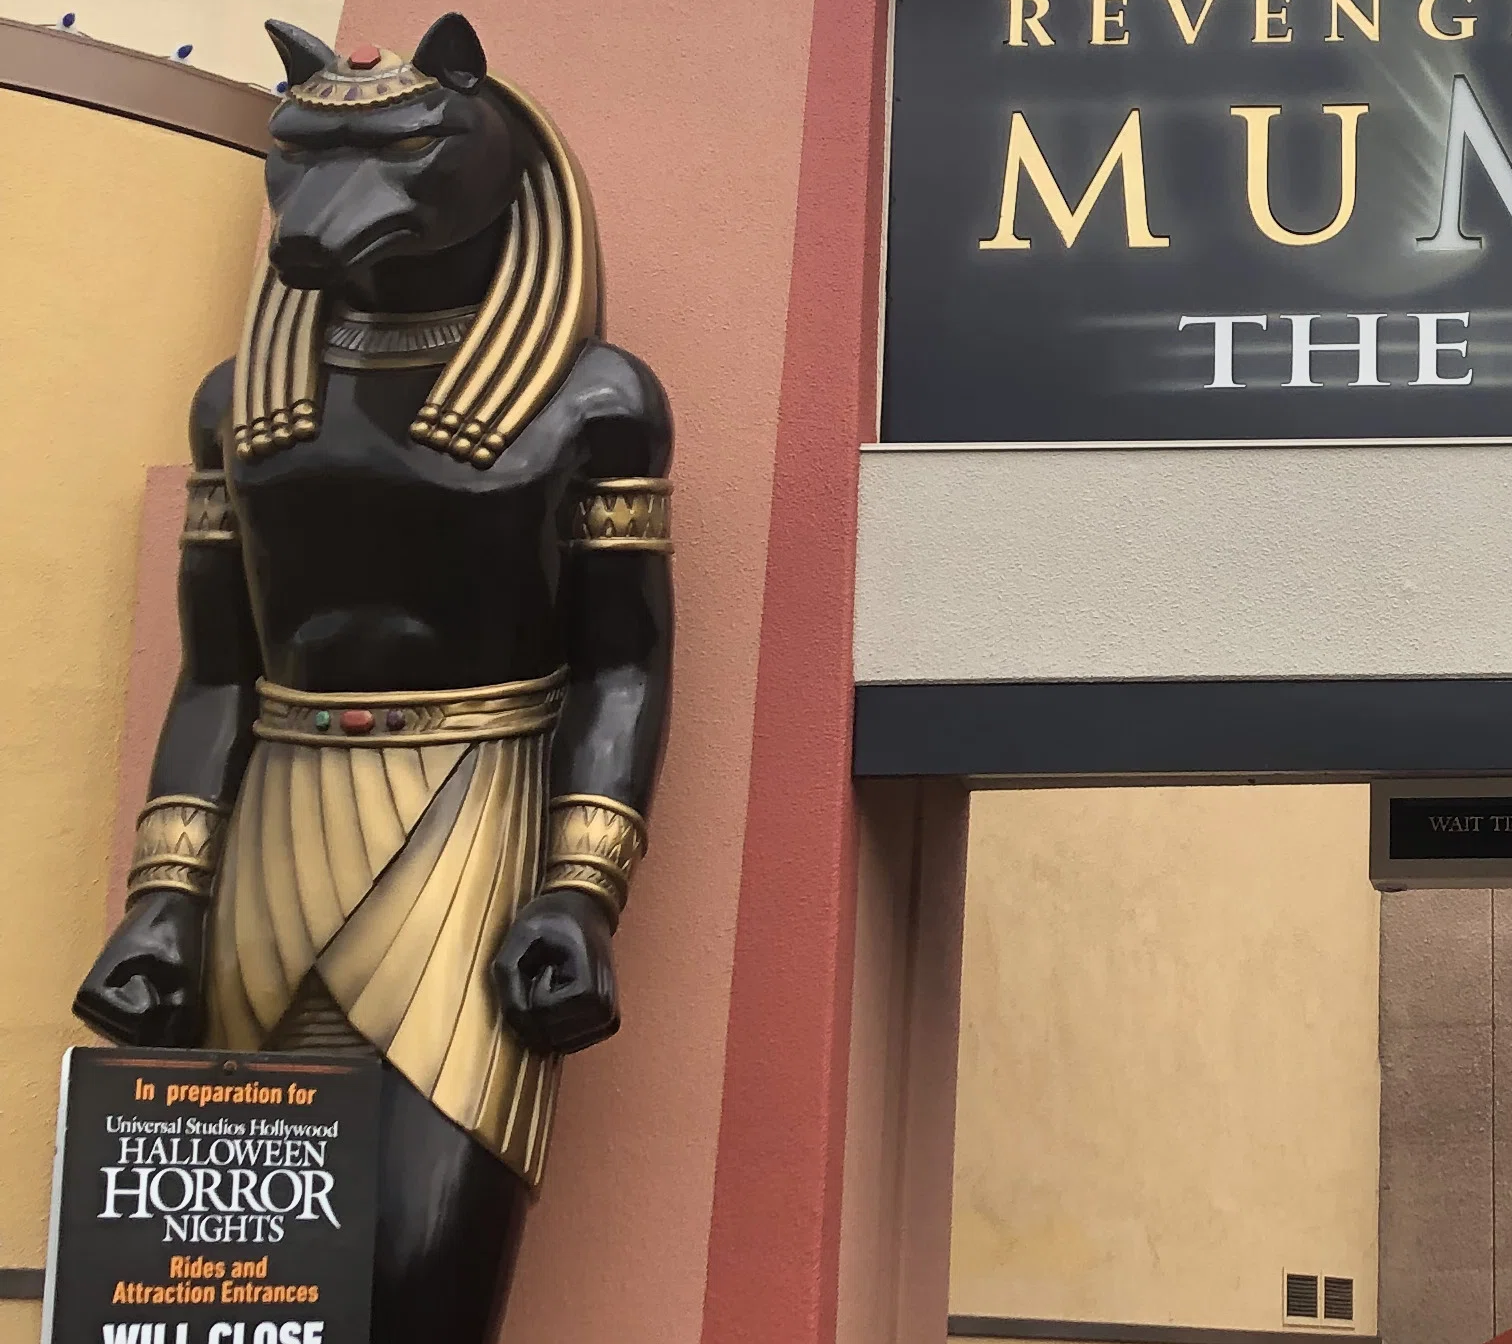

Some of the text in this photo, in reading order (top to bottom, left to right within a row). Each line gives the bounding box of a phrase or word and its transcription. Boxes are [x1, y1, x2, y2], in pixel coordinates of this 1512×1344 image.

[1178, 311, 1474, 389] THE
[1429, 815, 1484, 833] WAIT
[135, 1078, 317, 1107] In preparation for
[106, 1115, 339, 1140] Universal Studios Hollywood
[117, 1136, 327, 1168] HALLOWEEN
[97, 1167, 342, 1230] HORROR
[162, 1214, 285, 1244] NIGHTS
[169, 1255, 268, 1279] Rides and
[112, 1280, 319, 1305] Attraction Entrances
